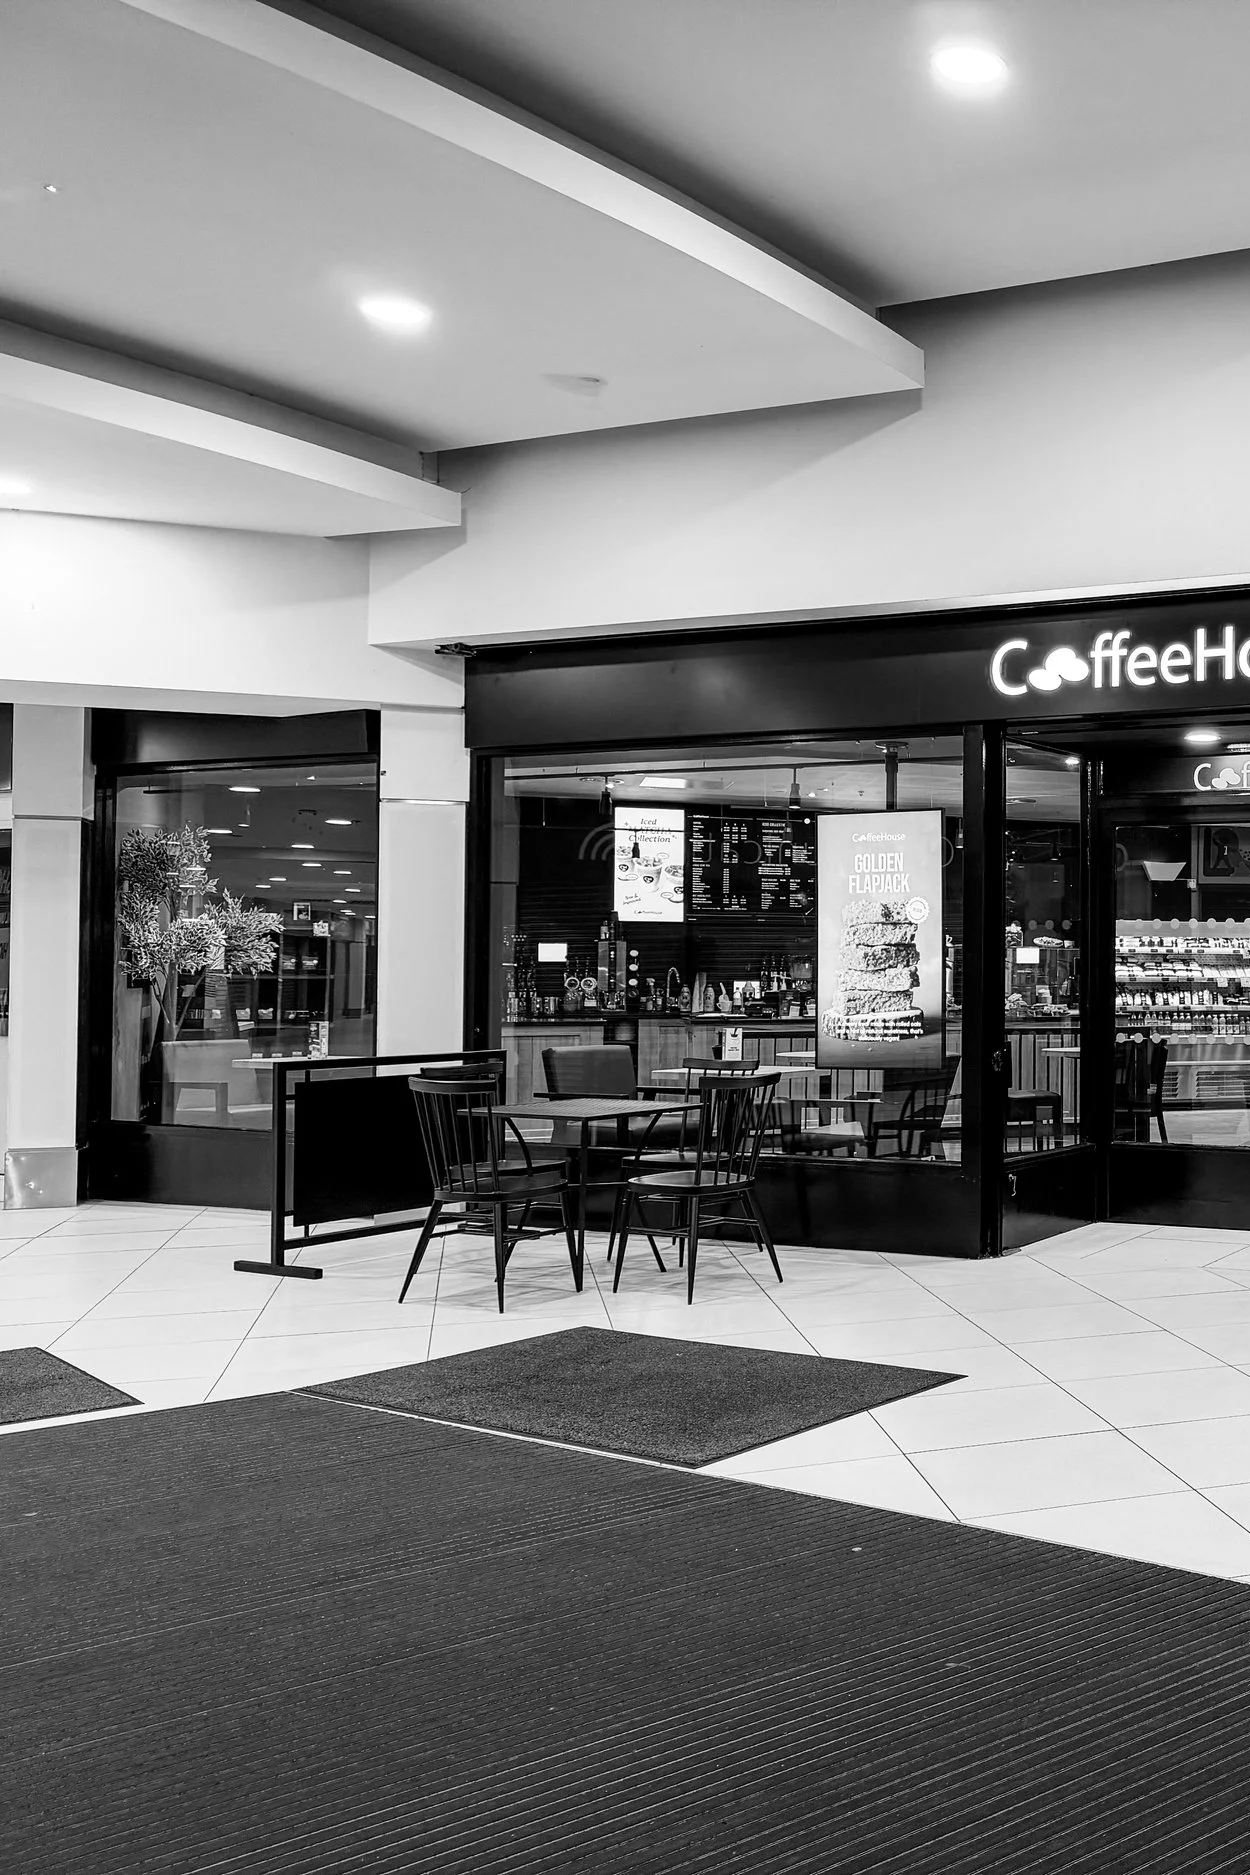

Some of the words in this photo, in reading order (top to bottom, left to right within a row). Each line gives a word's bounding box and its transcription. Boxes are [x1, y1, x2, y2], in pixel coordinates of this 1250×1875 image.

[640, 818, 657, 826] Iced
[854, 852, 904, 873] GOLDEN
[848, 873, 911, 894] FLAPJACK
